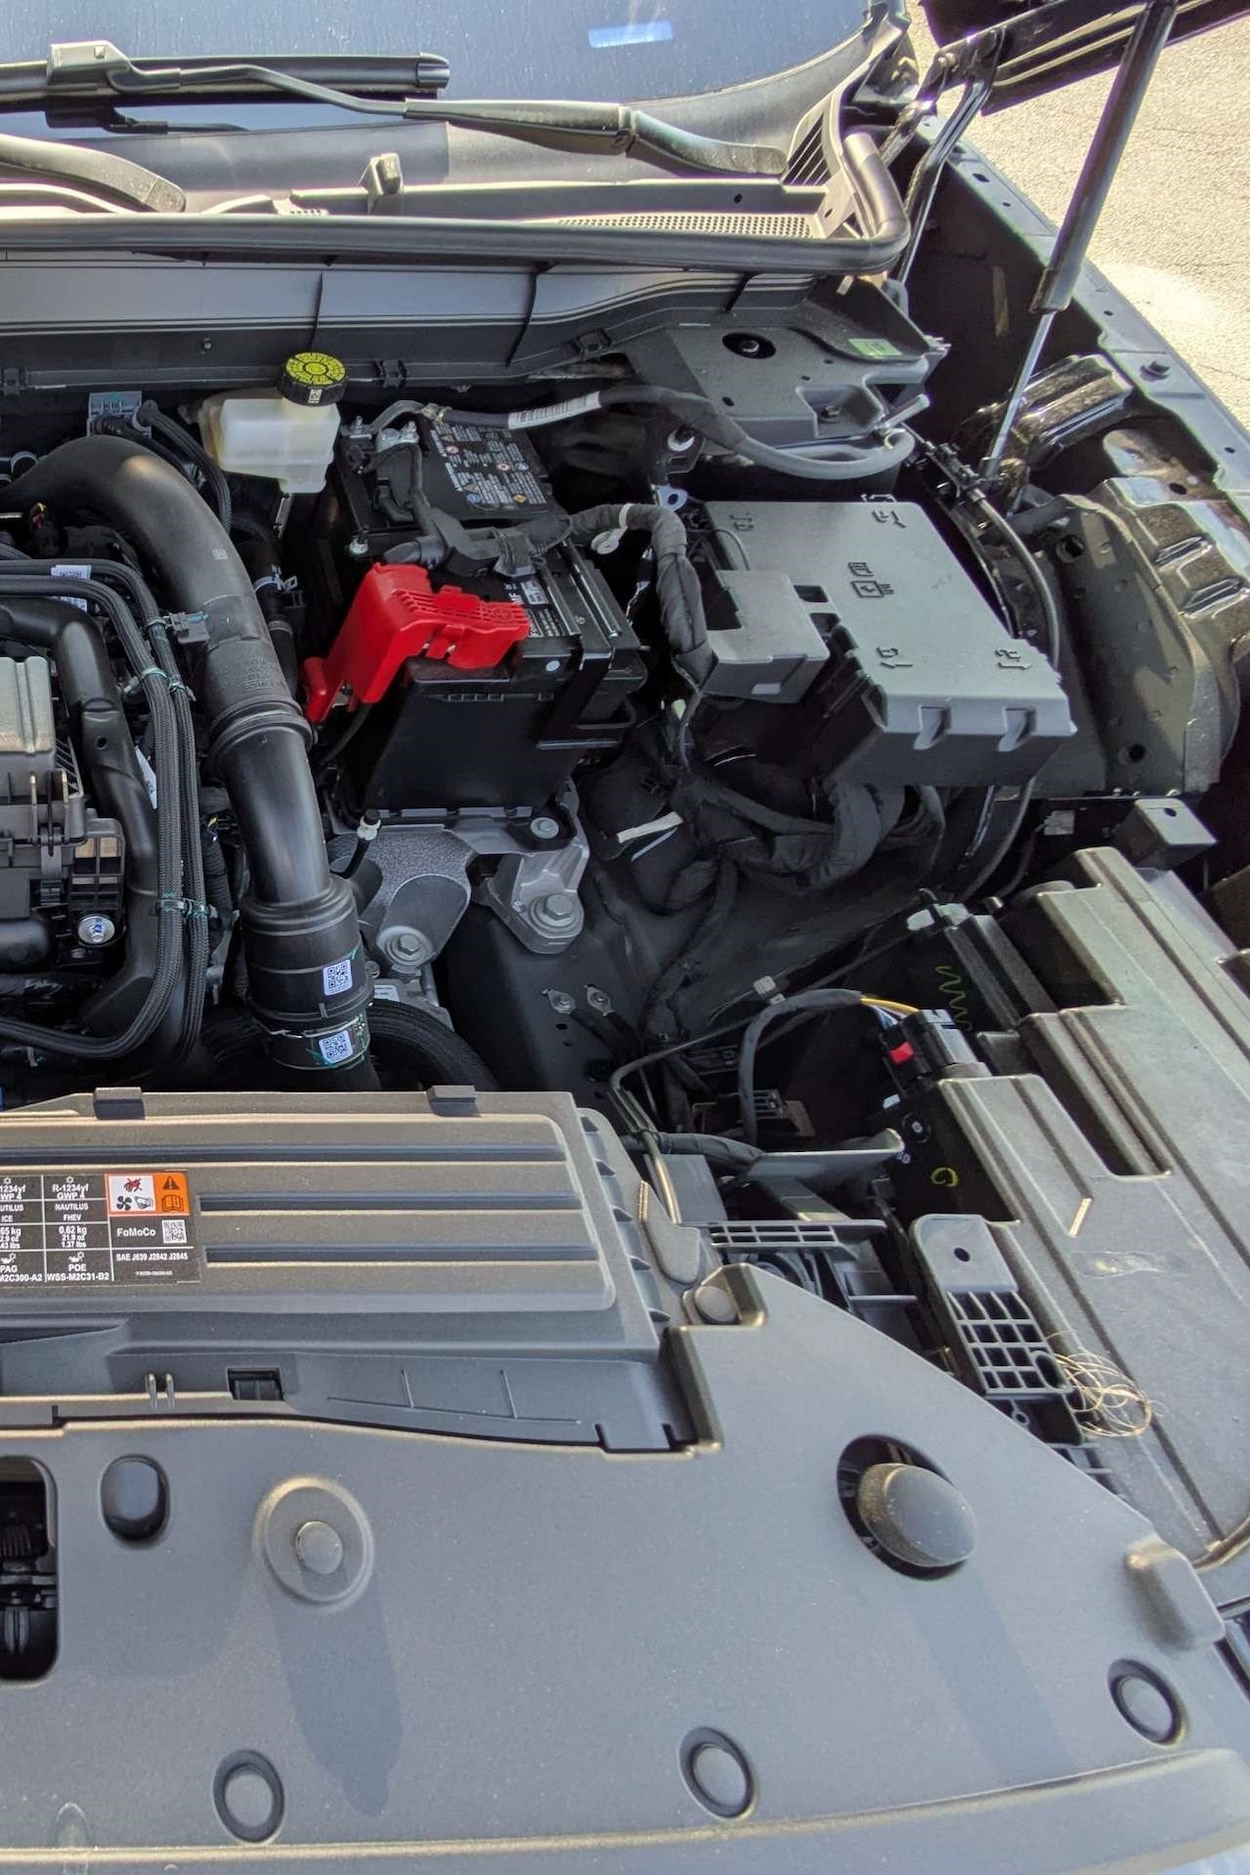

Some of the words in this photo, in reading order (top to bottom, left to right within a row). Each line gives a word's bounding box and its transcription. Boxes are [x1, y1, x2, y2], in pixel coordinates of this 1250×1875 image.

[52, 1183, 89, 1194] R-1234yf
[56, 1192, 78, 1200] GWP
[79, 1192, 86, 1200] 4
[54, 1203, 89, 1211] NAUTILUS
[1, 1215, 13, 1223] ICE
[62, 1213, 82, 1221] FHEV
[11, 1227, 21, 1237] kg
[58, 1226, 76, 1234] 0.62
[77, 1225, 87, 1235] kg
[116, 1227, 156, 1237] FoMoCo
[116, 1253, 131, 1261] SAE
[0, 1264, 18, 1273] PAG
[68, 1263, 87, 1272] POE
[46, 1272, 110, 1281] WSS-M2C31-B2
